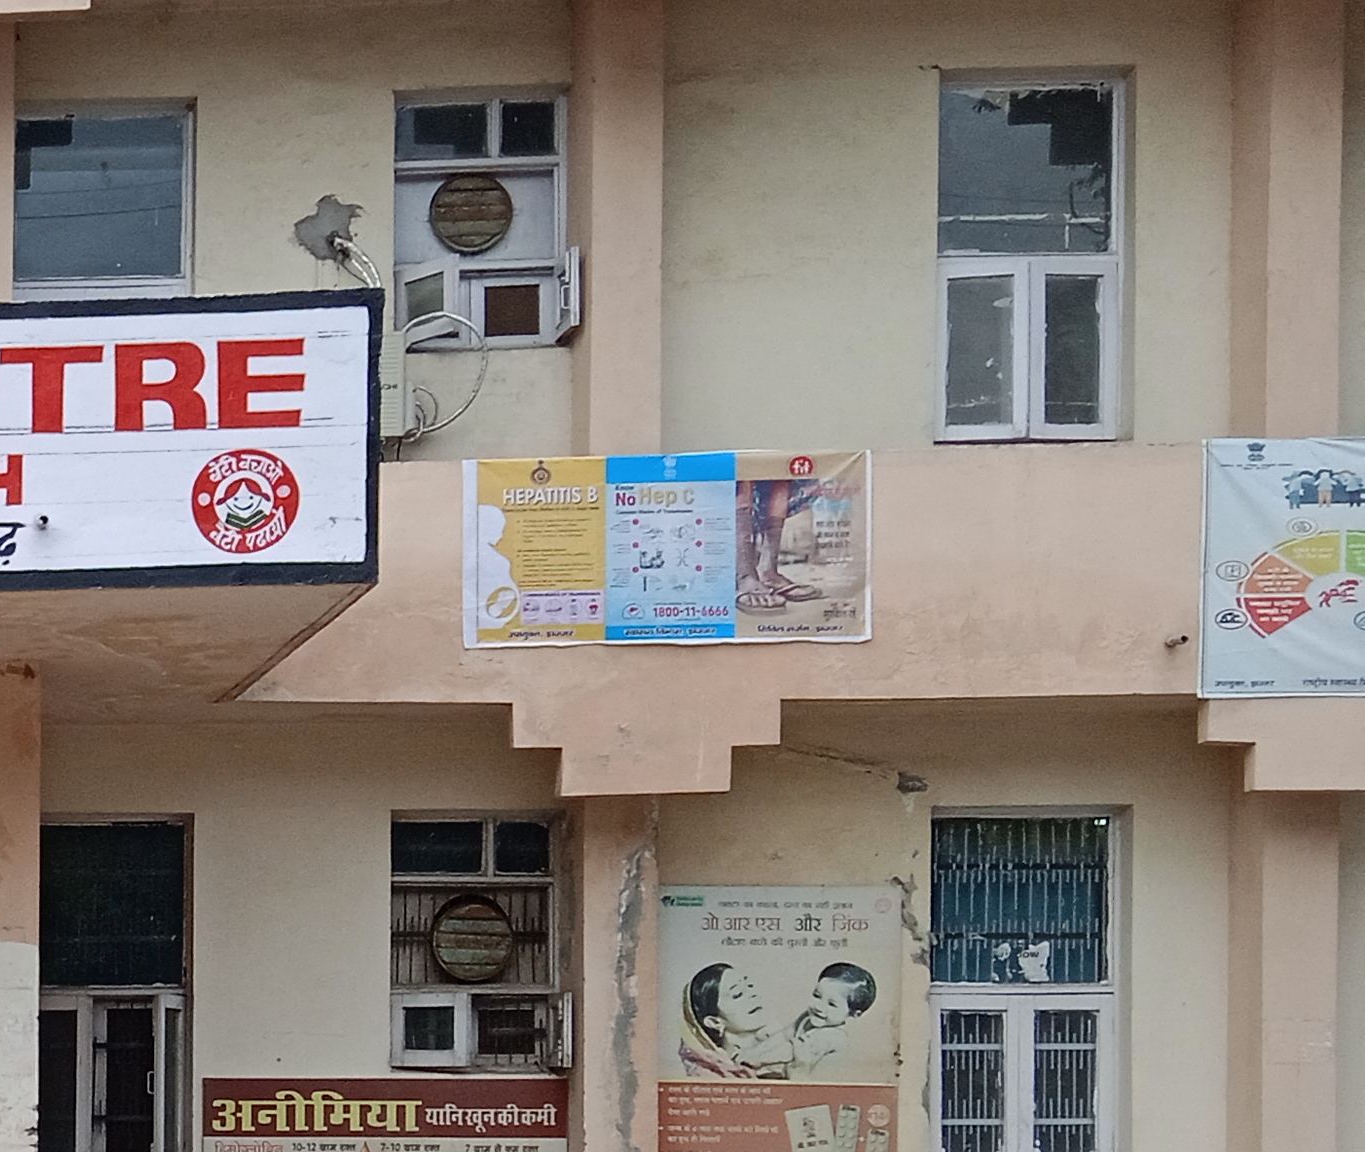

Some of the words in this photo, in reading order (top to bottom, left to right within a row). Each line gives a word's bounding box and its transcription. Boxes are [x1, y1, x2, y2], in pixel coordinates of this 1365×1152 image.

[502, 487, 582, 505] HEPATITIS
[588, 486, 600, 503] B
[616, 492, 636, 506] No
[639, 486, 678, 508] Hep
[683, 488, 695, 506] C
[653, 606, 729, 618] 1800-11-6666
[795, 913, 823, 932] और
[832, 913, 869, 932] जिंक
[211, 1090, 423, 1132] अनीमिया
[292, 1142, 317, 1152] 10-12
[380, 1142, 401, 1152] 7-10
[465, 1144, 471, 1152] 7
